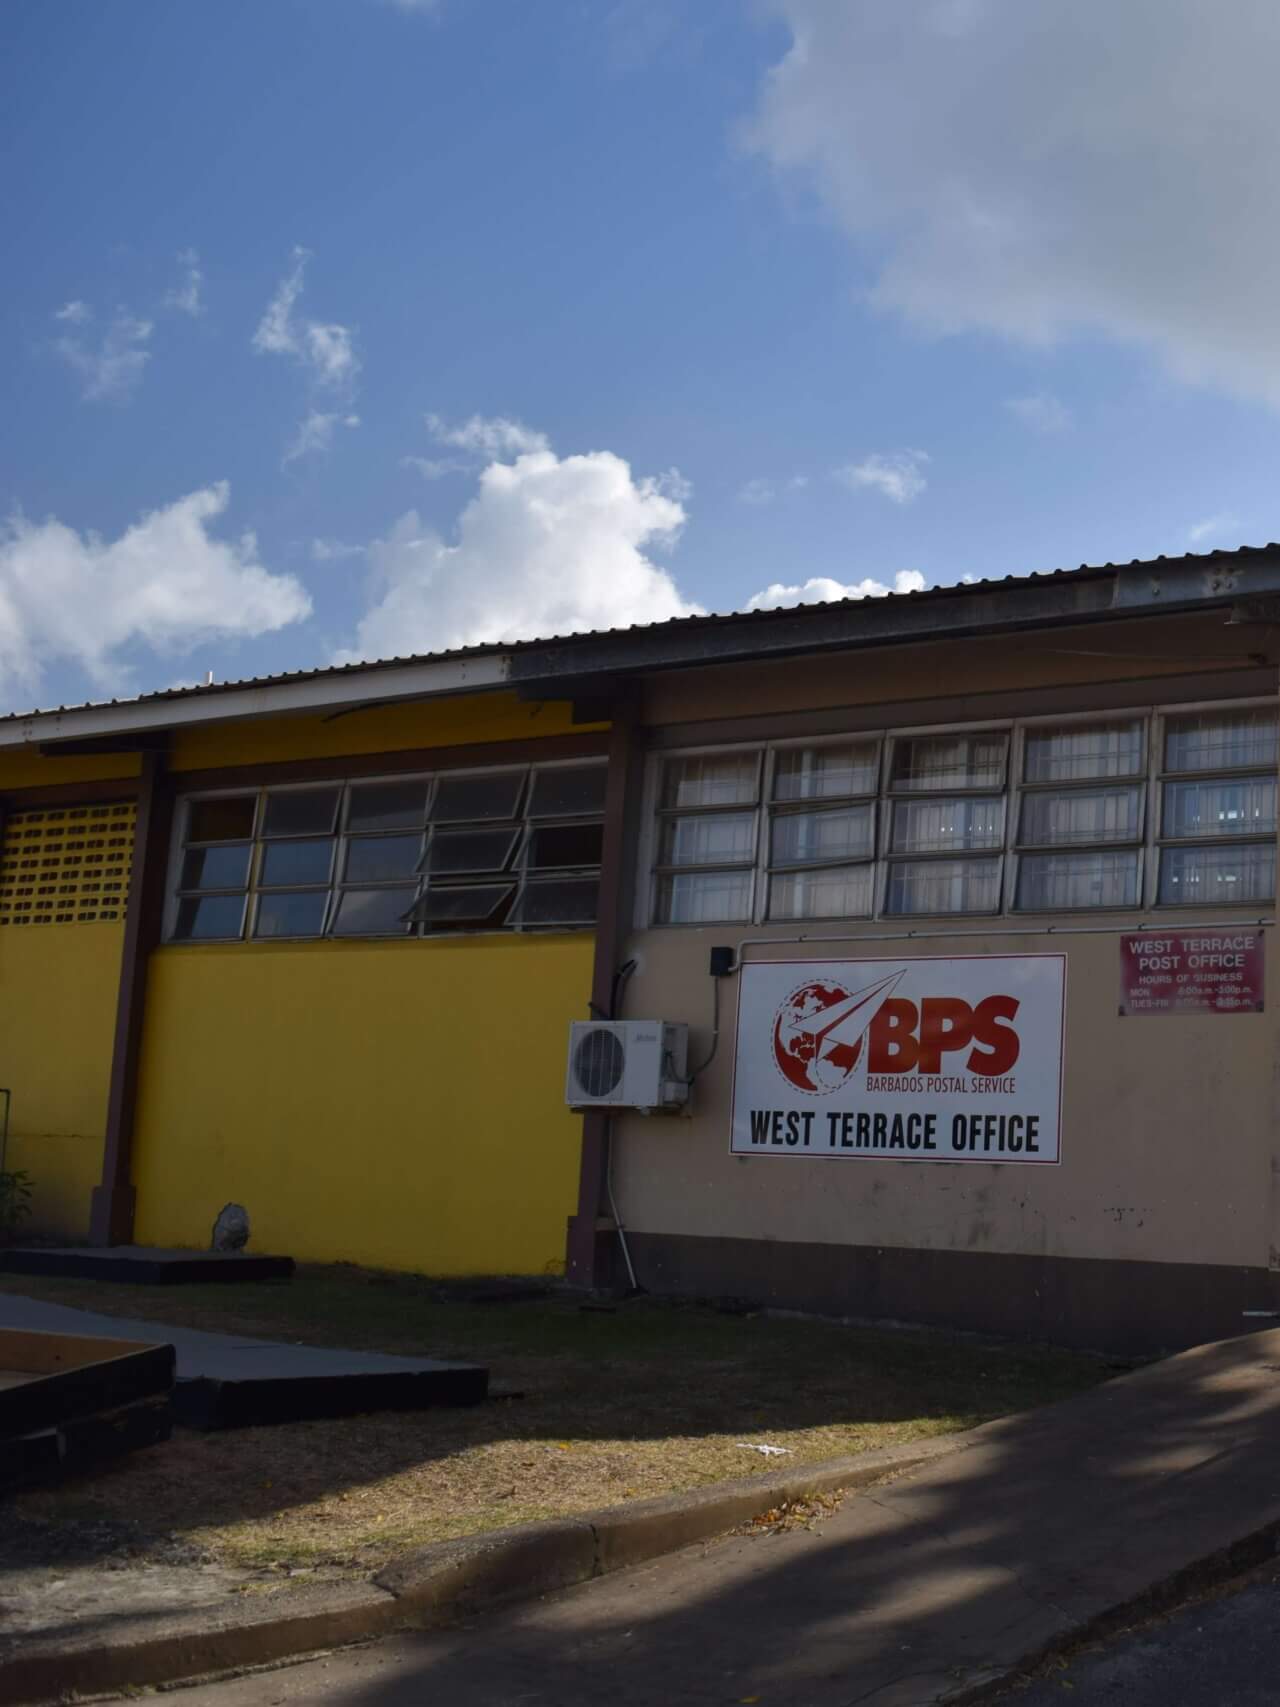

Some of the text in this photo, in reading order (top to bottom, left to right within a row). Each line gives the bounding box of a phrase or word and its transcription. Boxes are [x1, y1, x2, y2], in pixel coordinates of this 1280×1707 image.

[1129, 936, 1255, 954] WEST TERRACE
[1139, 954, 1246, 970] POST OFFICE
[1139, 972, 1243, 985] HOURS OF BUSINESS
[867, 994, 1021, 1077] BPS
[866, 1076, 1016, 1095] BARBADOS POSTAL SERVICE
[750, 1110, 1040, 1153] WEST TERRACE OFFICE
